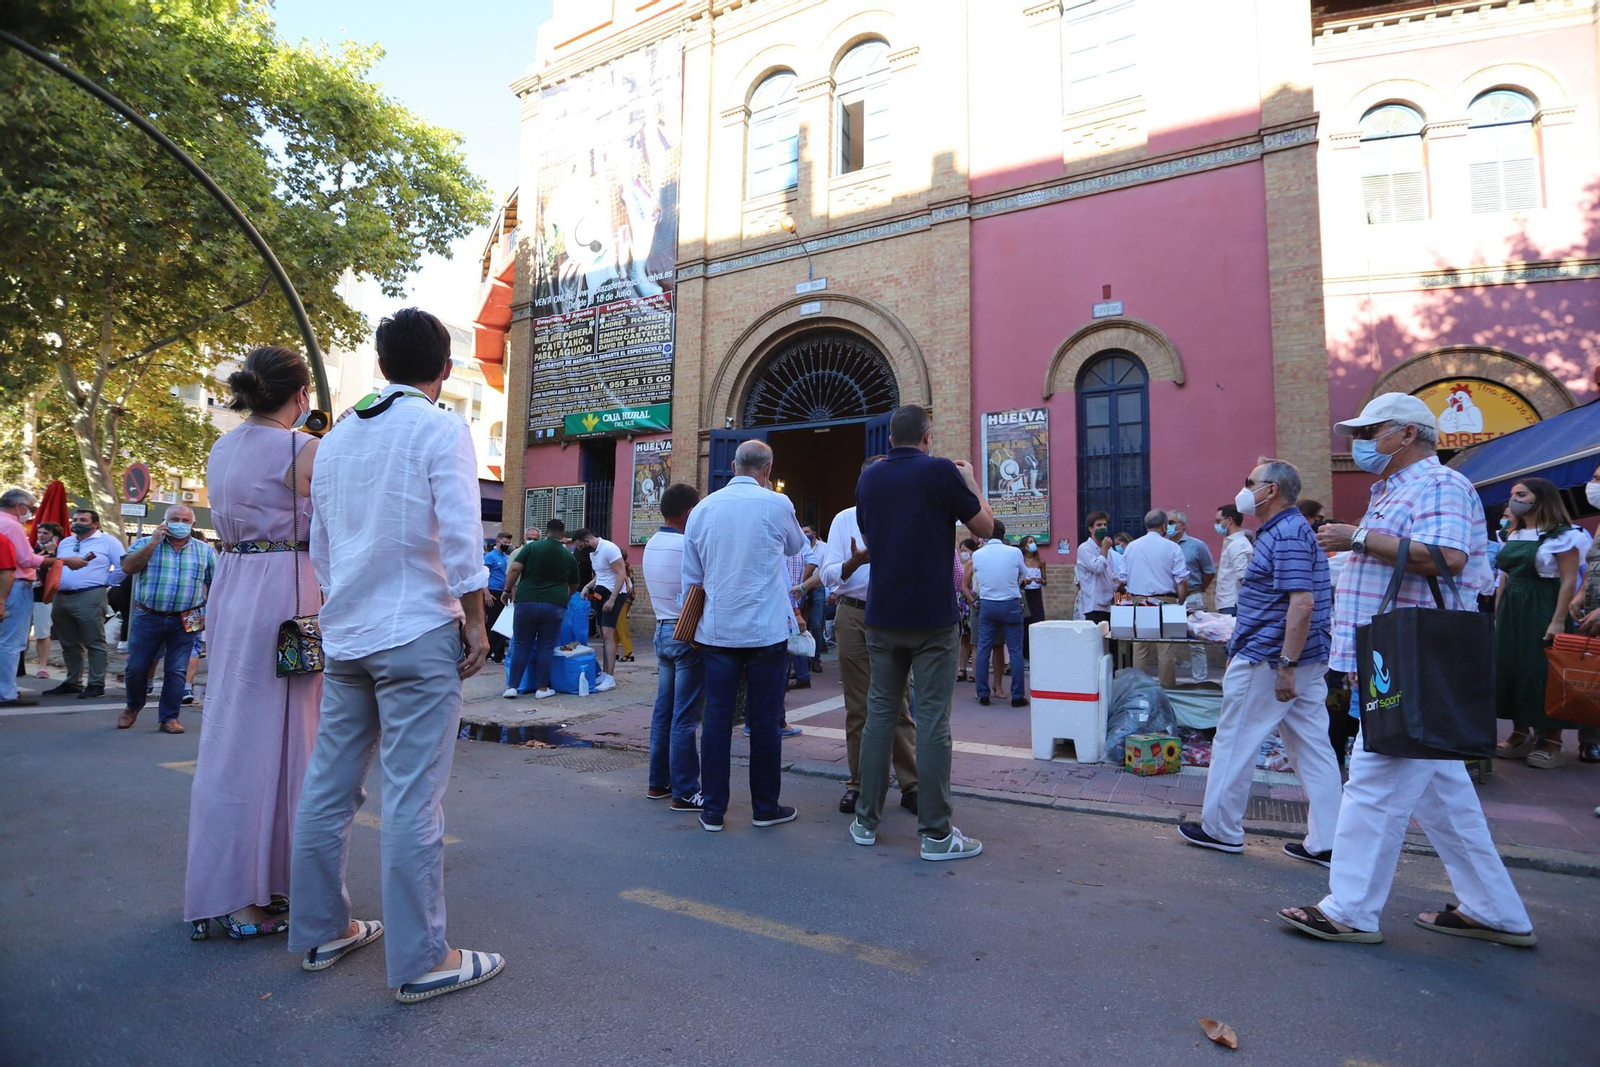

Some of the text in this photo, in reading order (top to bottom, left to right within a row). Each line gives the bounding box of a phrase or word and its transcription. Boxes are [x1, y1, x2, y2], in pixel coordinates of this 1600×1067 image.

[596, 294, 604, 302] 18
[605, 293, 613, 301] de
[615, 289, 632, 298] Julio
[606, 302, 628, 310] Lunes,
[639, 296, 664, 305] Agosto
[572, 310, 594, 318] Agosto
[599, 319, 627, 330] ANDRES
[631, 312, 671, 323] ROMERO
[563, 327, 594, 340] PERERA
[599, 327, 636, 339] ENRIQUE
[638, 323, 671, 332] PONCE
[623, 329, 670, 340] CASTELLA
[626, 334, 671, 345] MIRANDA
[534, 350, 557, 361] PABLO
[558, 344, 593, 357] AGUADO
[589, 382, 606, 391] Telf.
[609, 380, 625, 388] 959
[1420, 389, 1438, 401] ollos
[1476, 383, 1498, 396] Tfno.
[1501, 392, 1518, 405] 959
[1516, 405, 1527, 415] 26
[602, 410, 650, 422] CAJA RURAL
[988, 410, 1045, 425] HUELVA
[637, 441, 672, 452] HUELVA
[1379, 693, 1401, 708] sport
